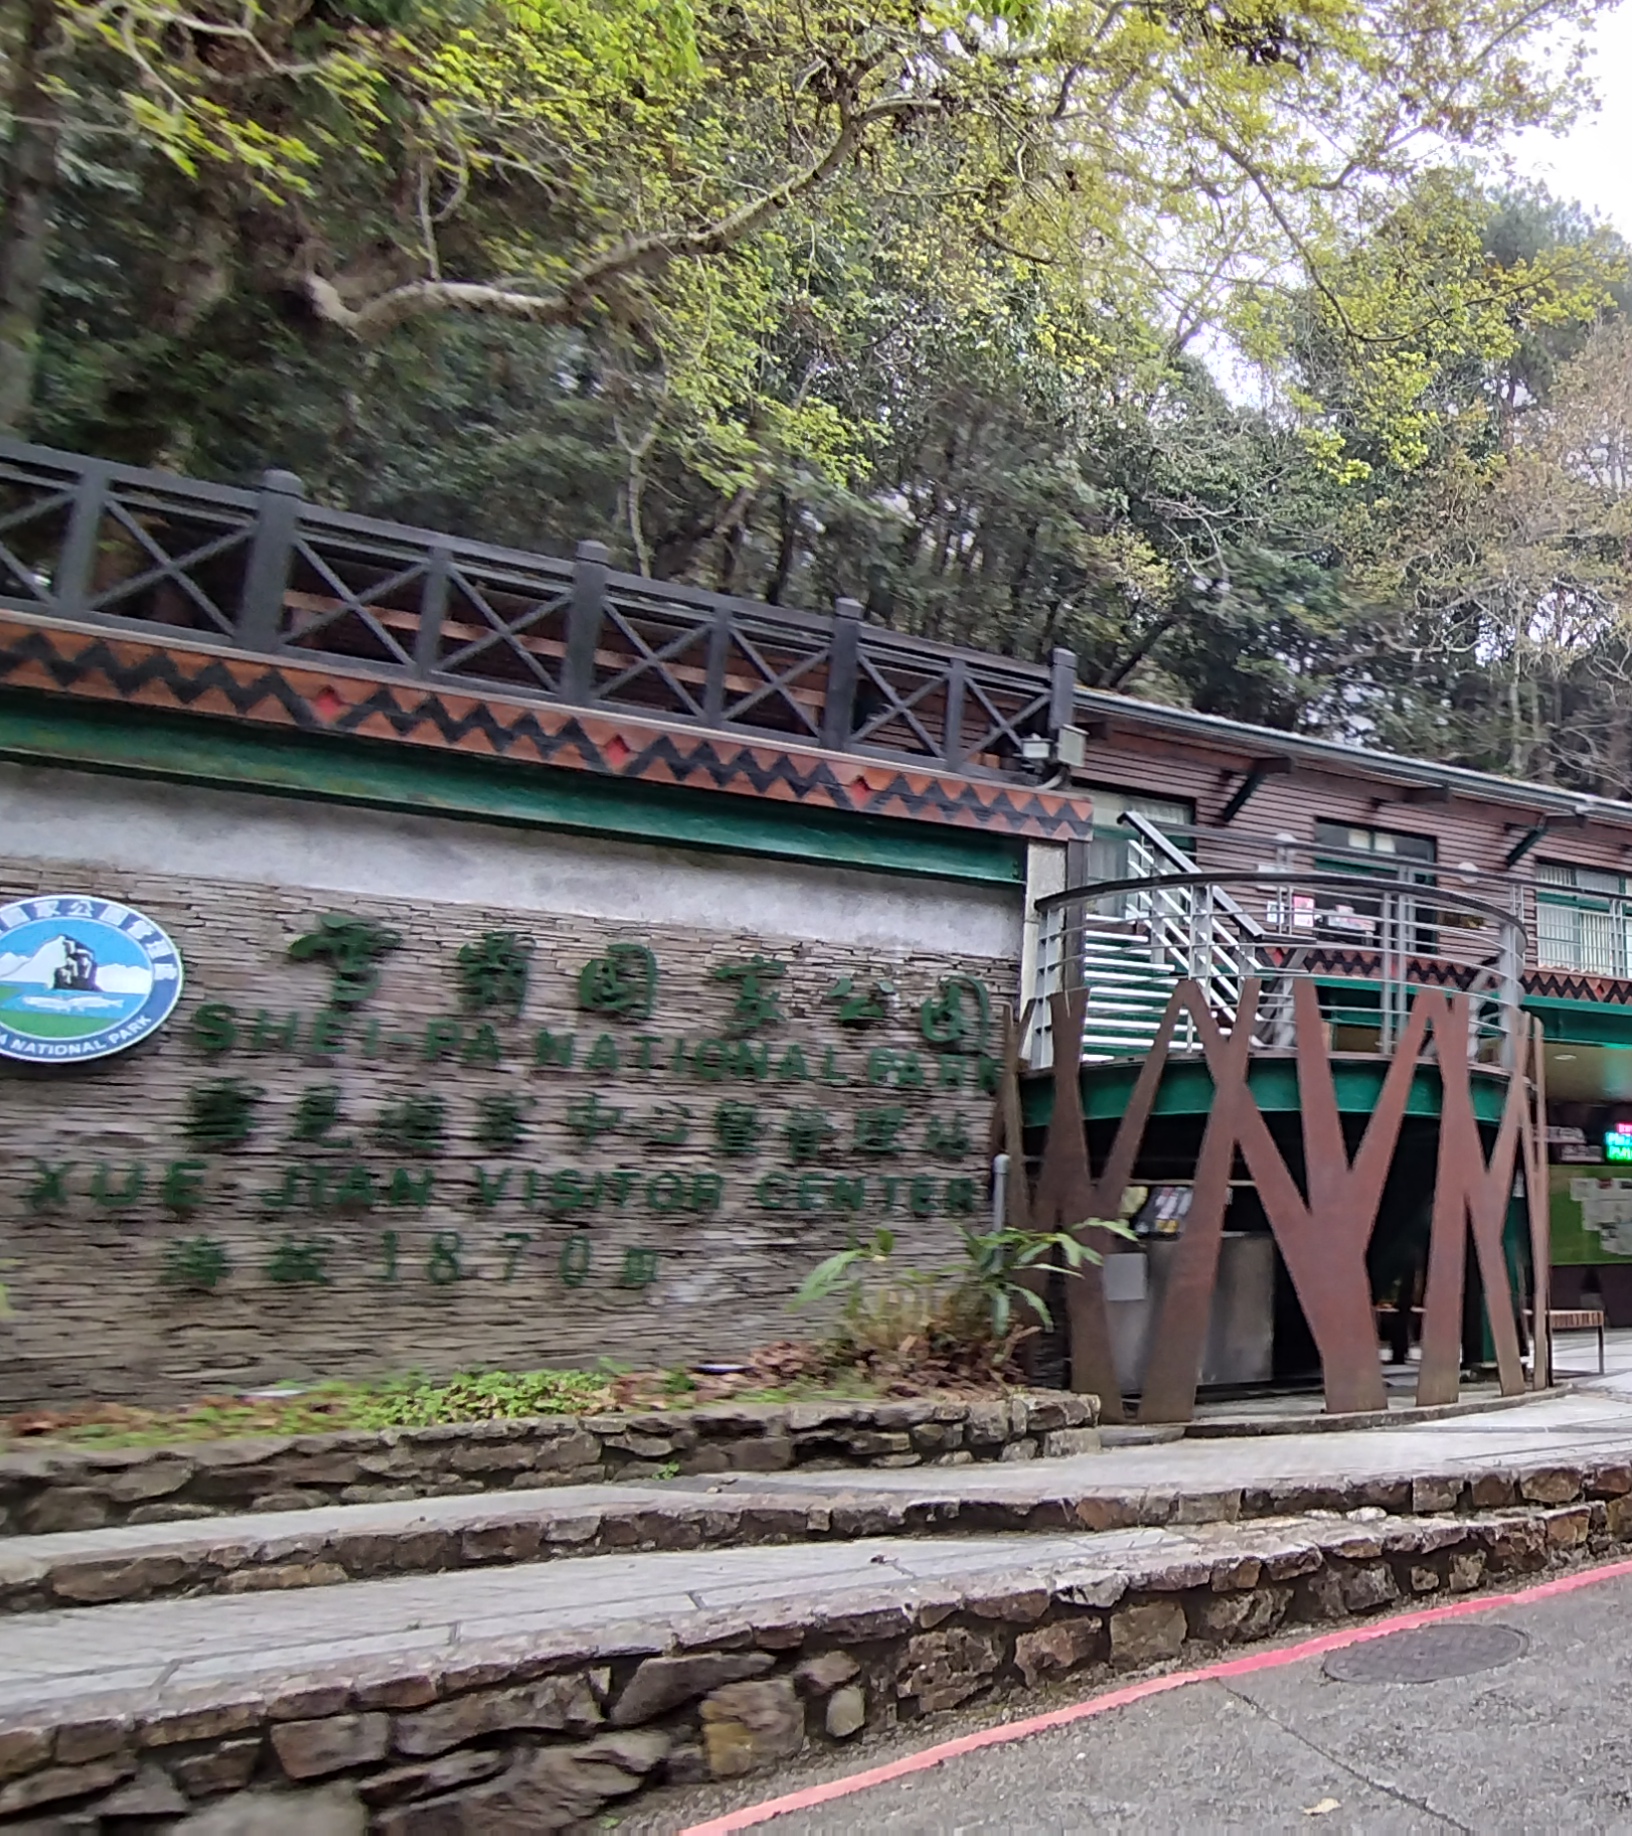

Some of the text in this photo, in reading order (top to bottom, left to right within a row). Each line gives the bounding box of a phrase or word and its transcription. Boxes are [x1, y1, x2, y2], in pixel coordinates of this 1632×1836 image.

[9, 1038, 107, 1056] NATIONAL
[107, 1014, 152, 1045] PARK
[196, 1002, 499, 1063] SHEI-PA
[535, 1028, 848, 1081] NATIONAL
[28, 1160, 978, 1214] XUE JIAN VISITOR CENTER
